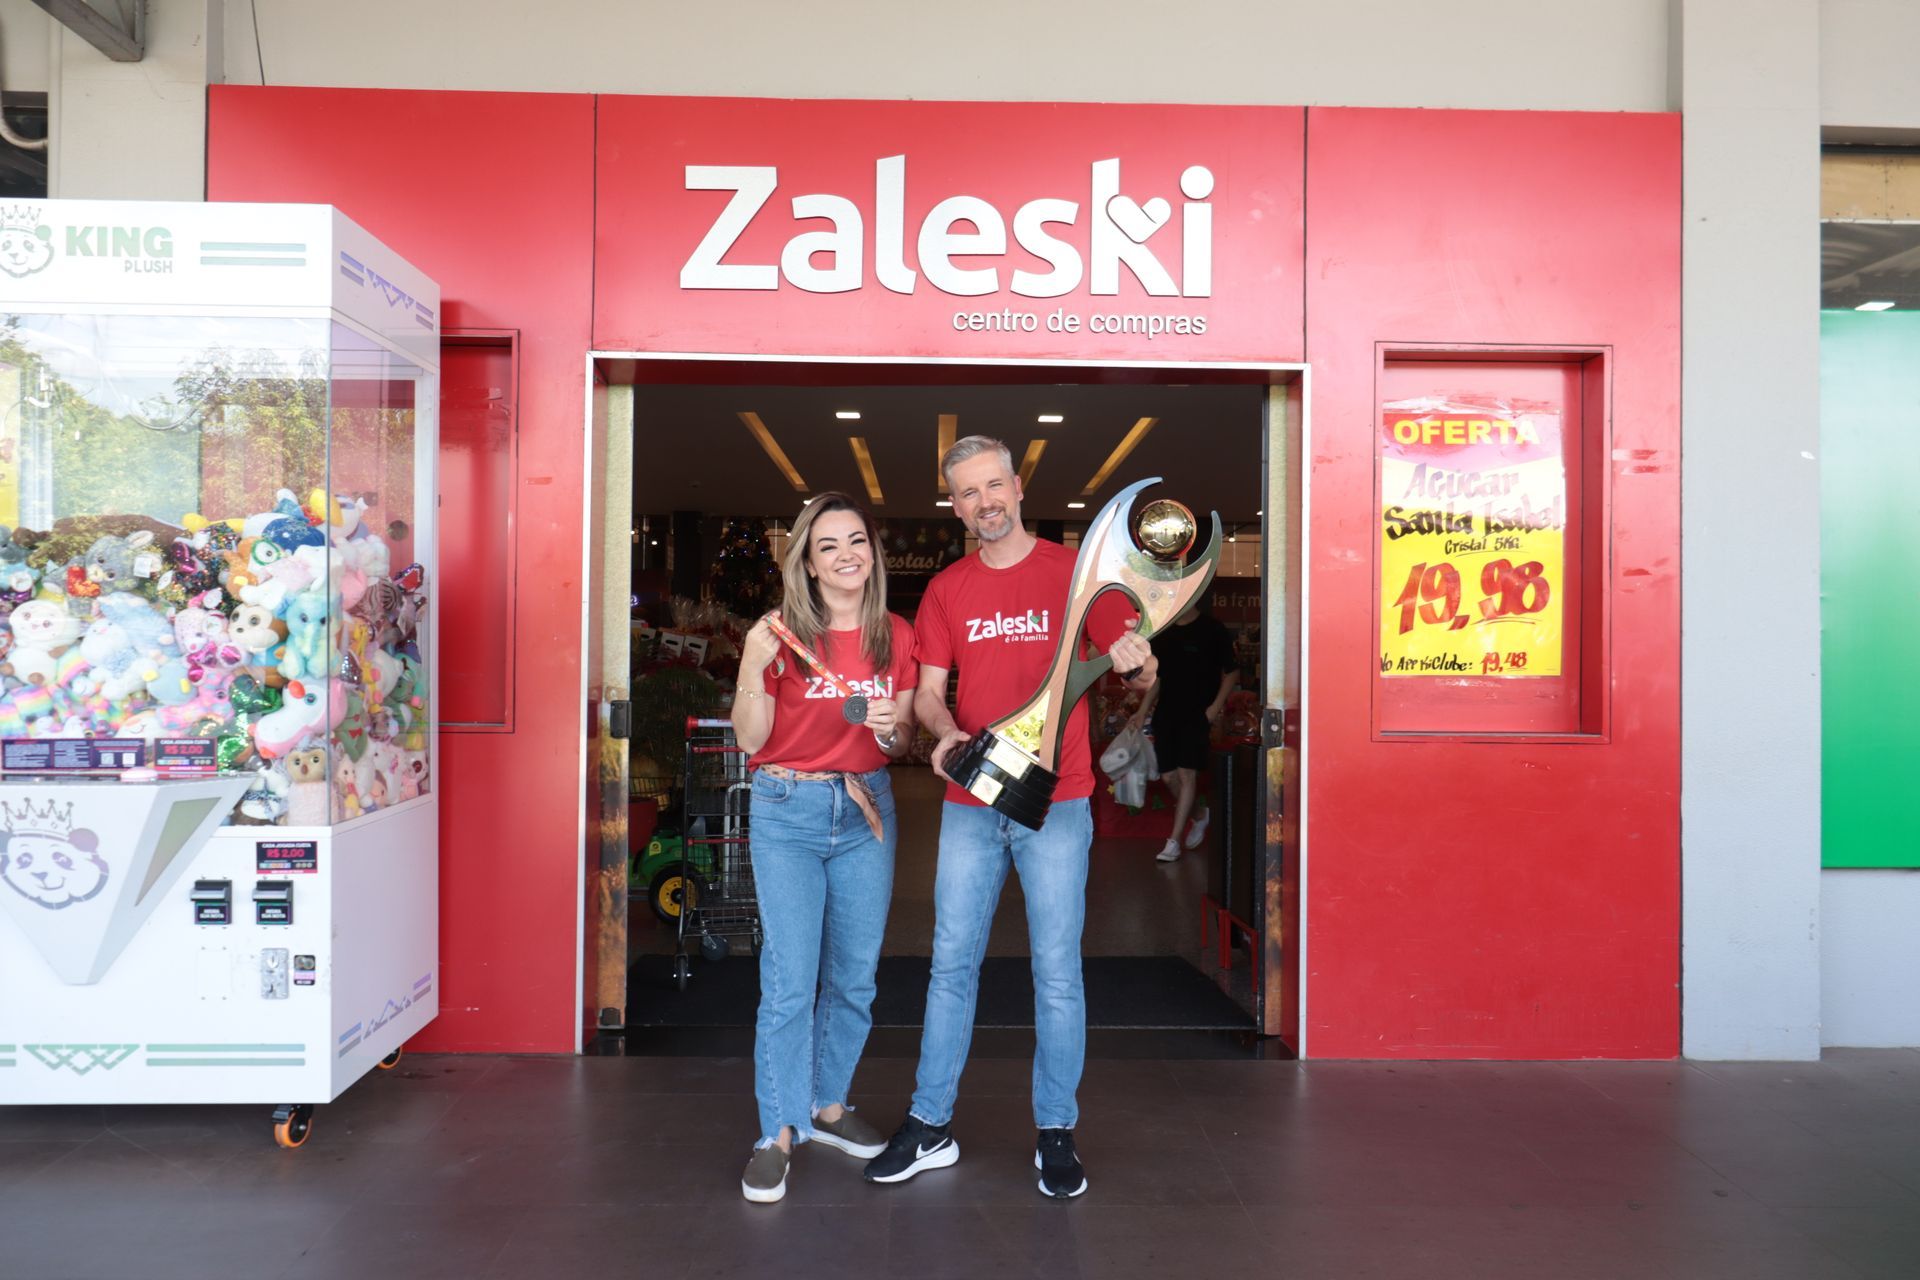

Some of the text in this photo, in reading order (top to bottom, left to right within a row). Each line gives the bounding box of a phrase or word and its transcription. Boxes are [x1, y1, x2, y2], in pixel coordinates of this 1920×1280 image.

[680, 154, 1214, 298] Zaleski
[65, 226, 174, 258] KING
[124, 260, 173, 274] PLUSH
[953, 308, 1207, 339] centro de compras
[1393, 419, 1540, 445] OFERTA
[1383, 501, 1473, 541] Santa
[1444, 538, 1487, 555] Cristal
[1392, 558, 1550, 635] 19,98
[965, 609, 1049, 643] Zaleski
[1480, 651, 1528, 674] 19,48
